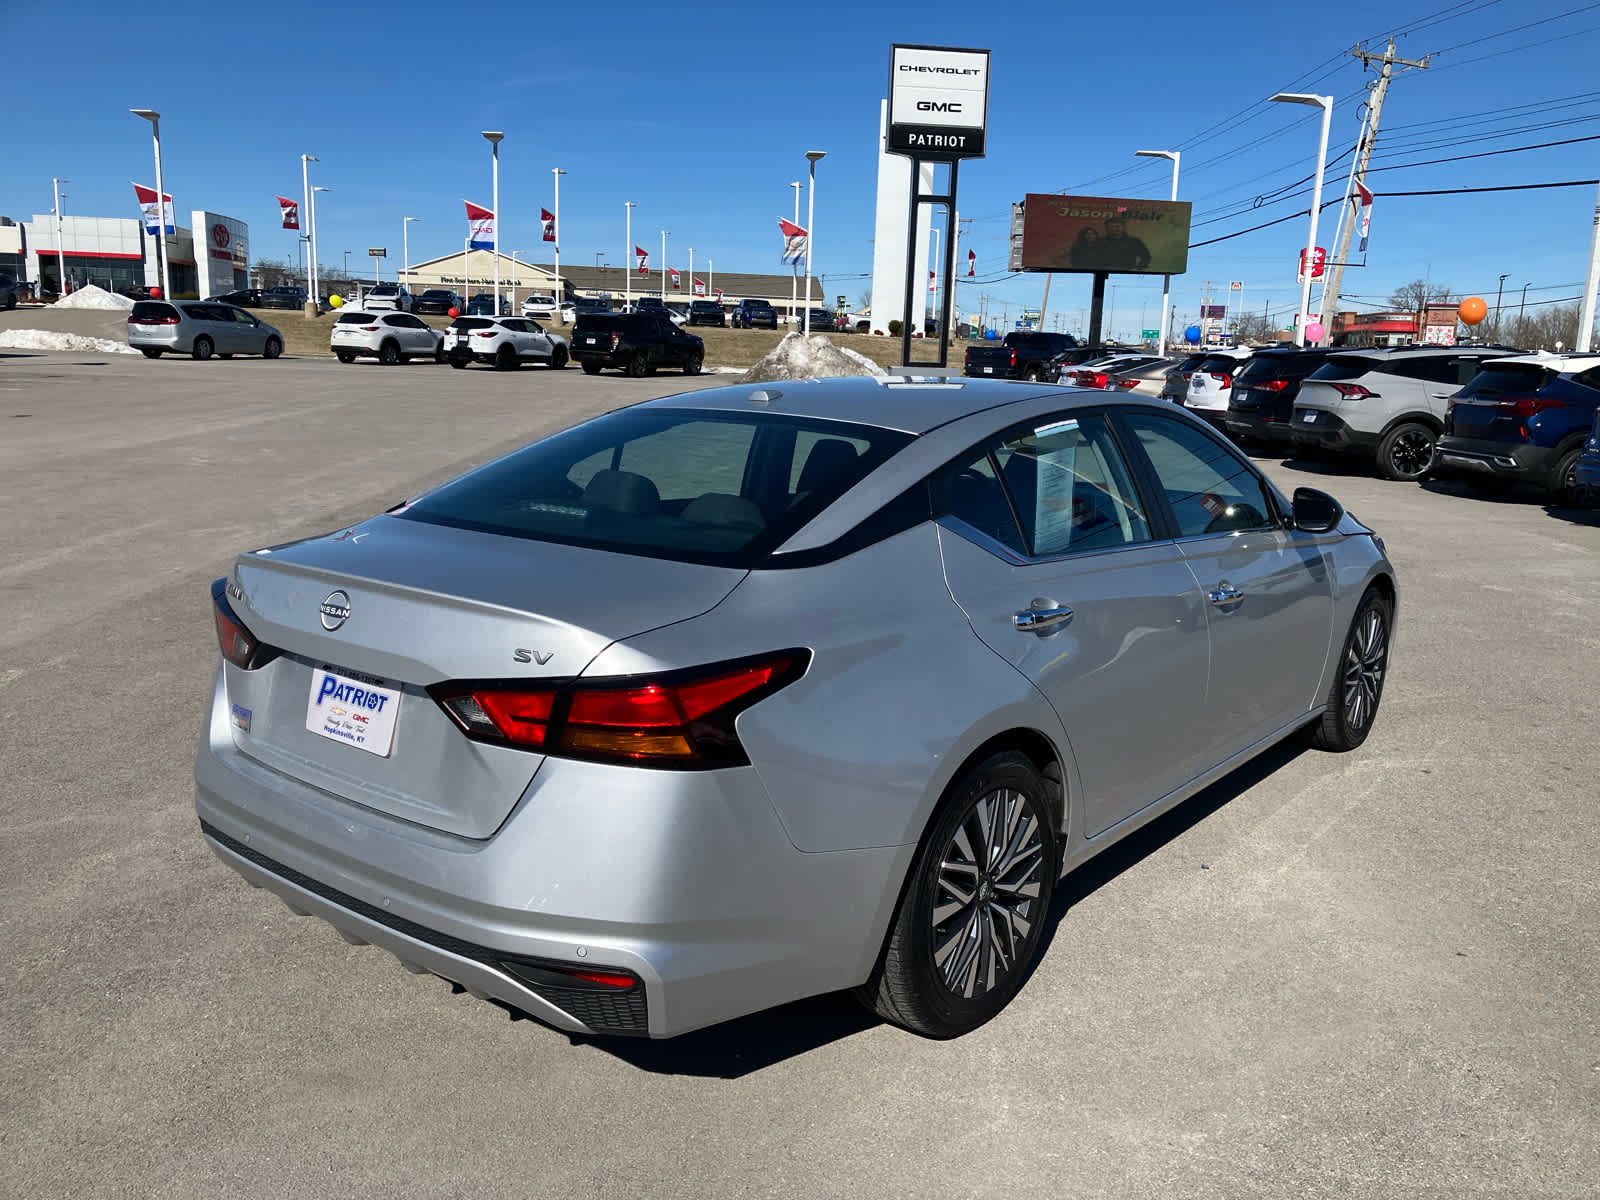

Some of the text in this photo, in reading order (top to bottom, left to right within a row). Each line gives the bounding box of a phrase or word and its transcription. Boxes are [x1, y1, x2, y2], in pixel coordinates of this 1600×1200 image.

[899, 65, 980, 75] CHEVROLET
[916, 101, 962, 112] GMC
[908, 133, 966, 148] PATRIOT
[1057, 206, 1114, 219] Jason
[320, 604, 350, 619] NISSAN
[513, 648, 554, 666] SV
[316, 674, 389, 713] PATRIOT
[352, 713, 370, 725] GMC
[356, 735, 366, 743] KY
